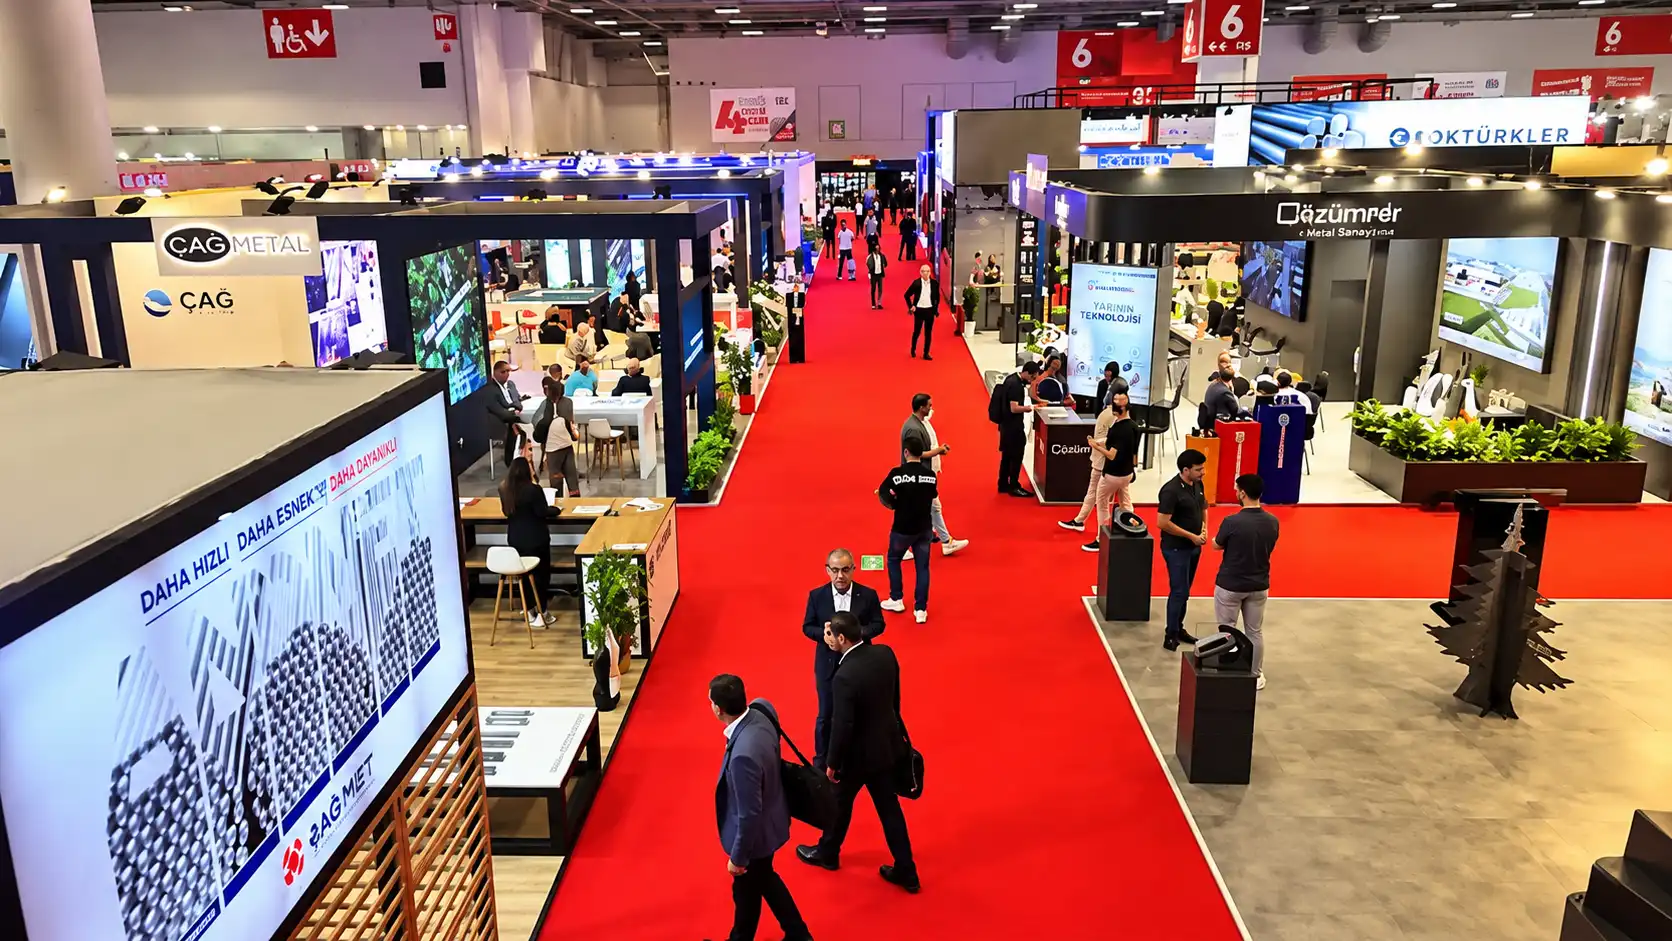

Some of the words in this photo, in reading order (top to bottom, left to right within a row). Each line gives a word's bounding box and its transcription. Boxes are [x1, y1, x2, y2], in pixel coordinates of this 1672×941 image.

[1221, 5, 1244, 39] 6
[1605, 21, 1622, 45] 6
[1072, 39, 1092, 68] 6
[232, 236, 310, 253] METAL
[1307, 228, 1335, 237] Metal
[179, 287, 234, 314] ÇAĞ
[1080, 311, 1141, 325] TEKNOLOJİSİ
[329, 463, 355, 492] DAHA
[355, 437, 397, 474] DAYANIKLI
[236, 514, 275, 552] DAHA
[276, 488, 316, 527] ESNEK
[140, 568, 191, 614] DAHA
[192, 541, 230, 580] HIZLI
